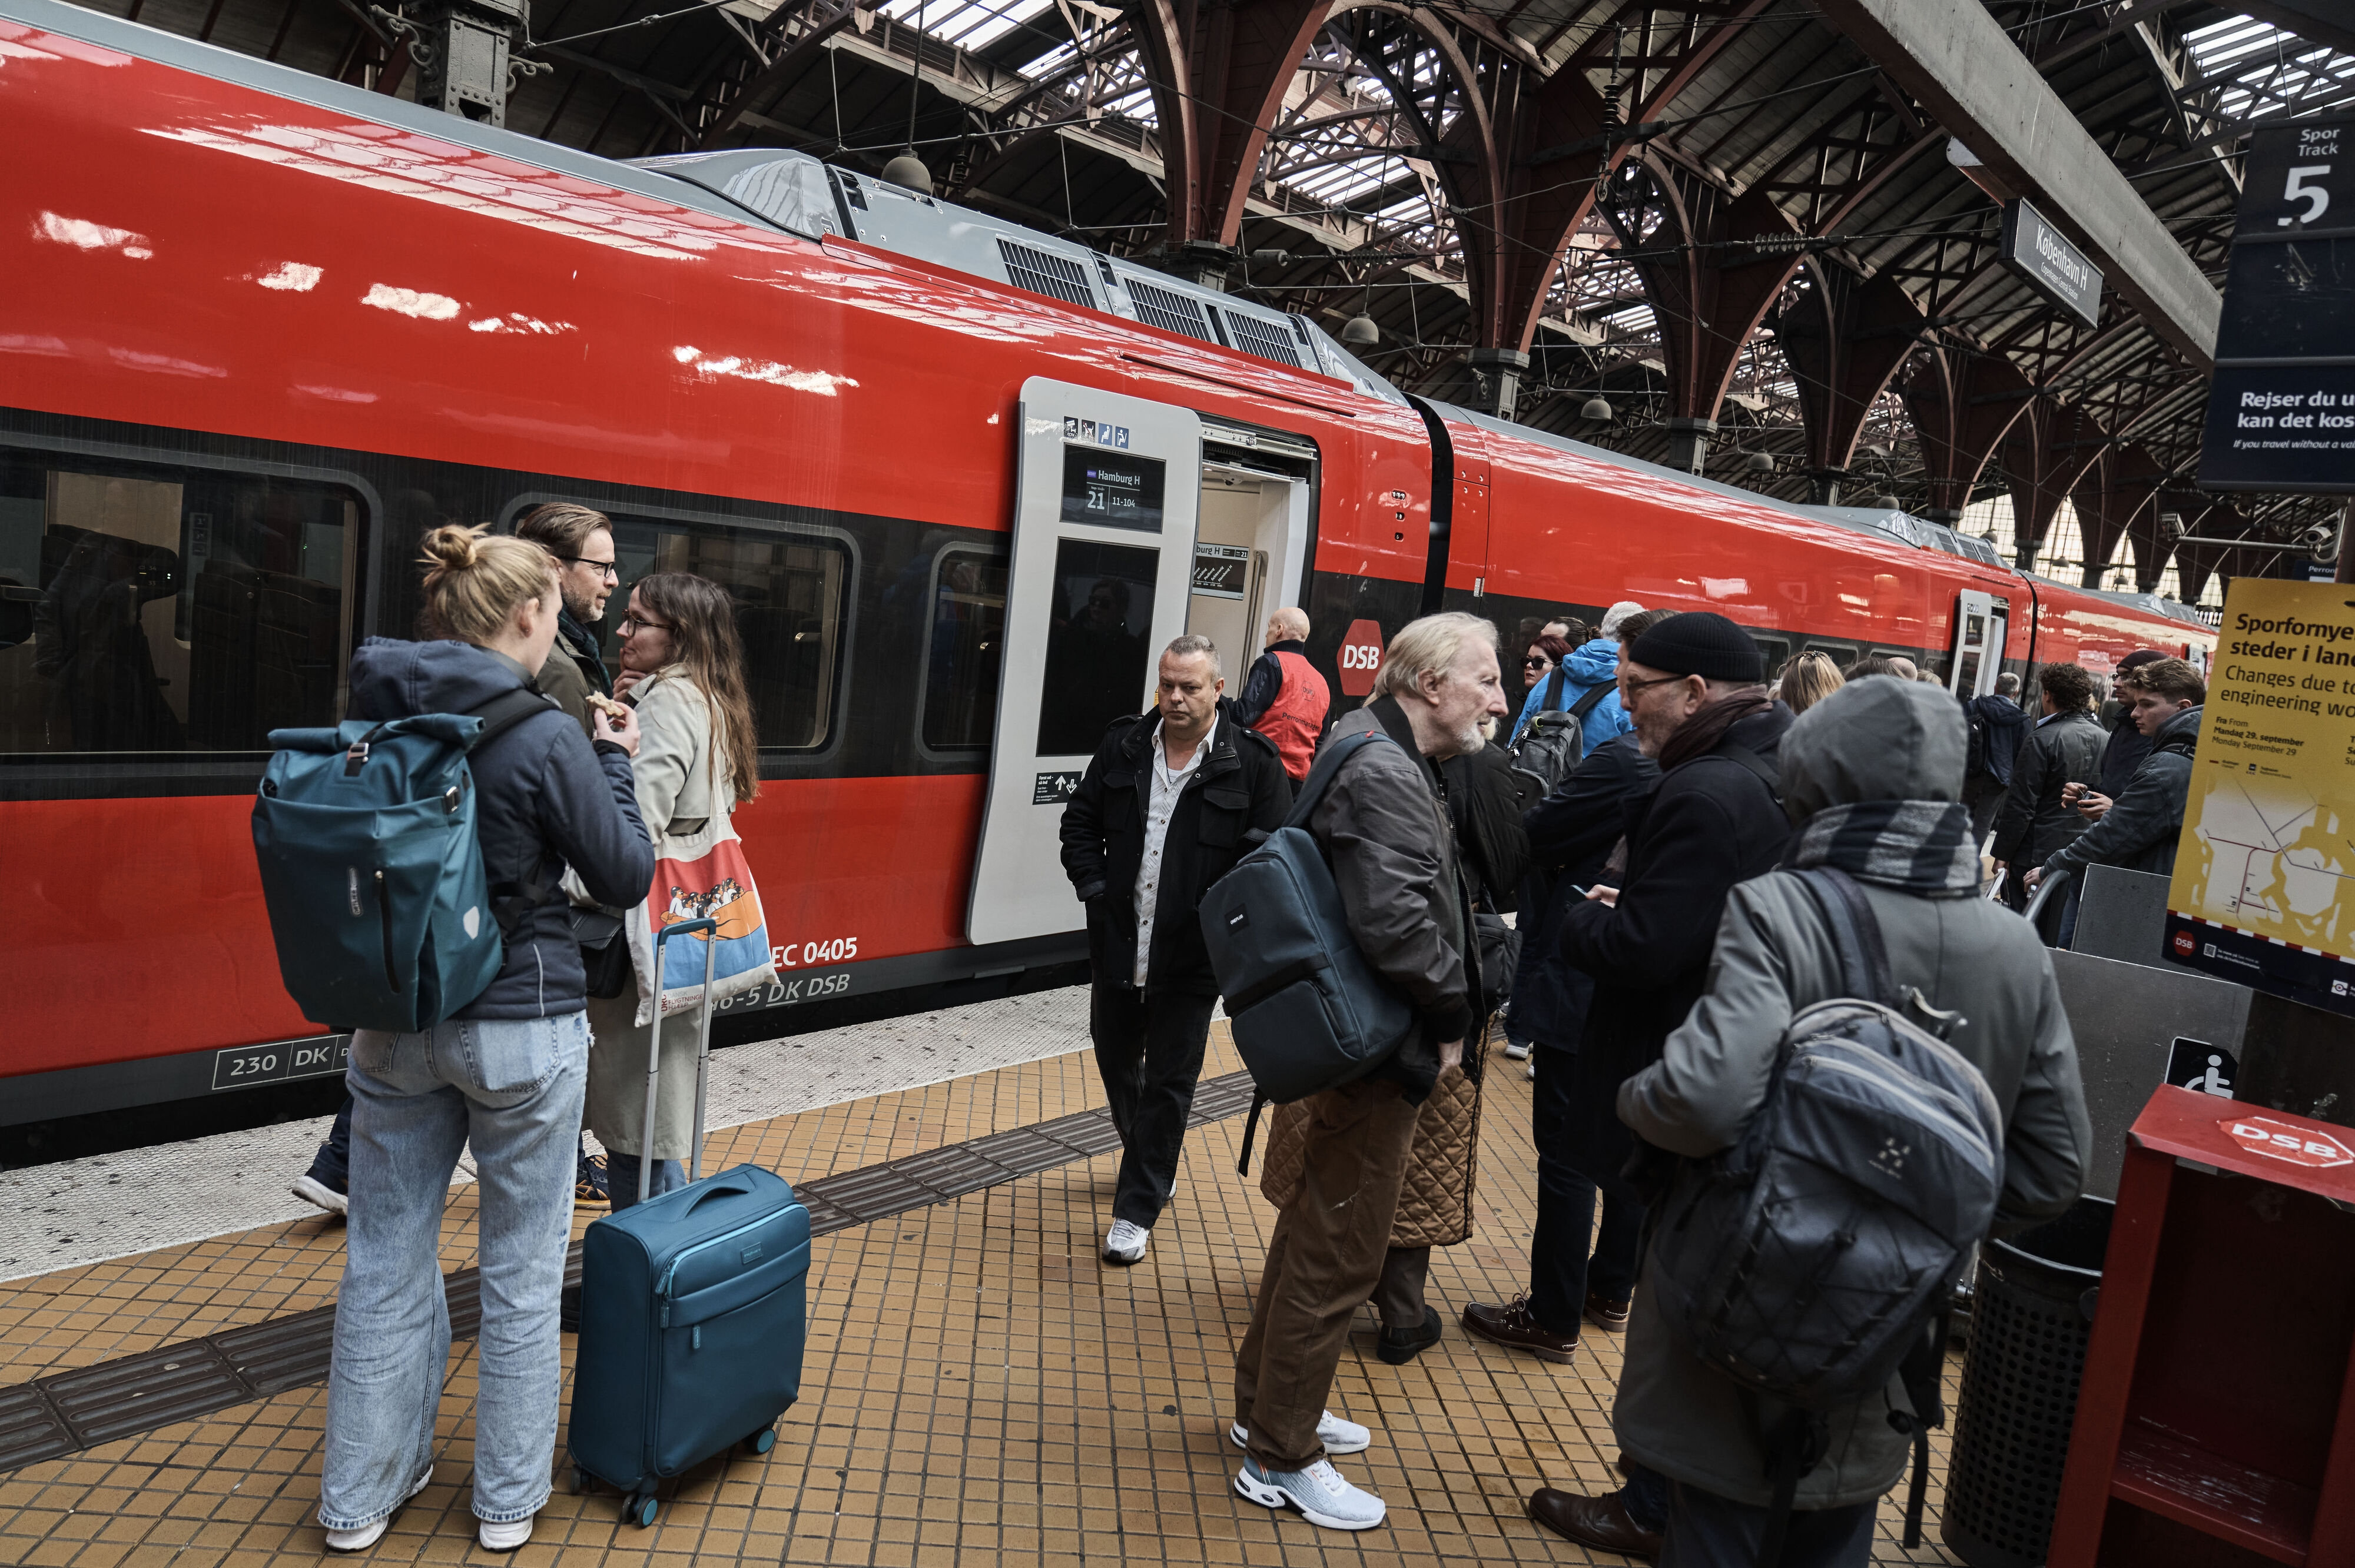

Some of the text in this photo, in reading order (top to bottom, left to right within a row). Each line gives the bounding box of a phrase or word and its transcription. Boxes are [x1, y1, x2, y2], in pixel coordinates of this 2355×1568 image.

[2301, 128, 2340, 142] Spor
[2298, 142, 2339, 157] Track
[2277, 165, 2331, 226] 5
[2036, 224, 2088, 291] København H
[2041, 262, 2078, 301] Copenhagen Central Station
[2241, 392, 2304, 410] Rejser
[2308, 390, 2336, 406] du
[2237, 412, 2274, 428] kan
[2279, 412, 2314, 428] det
[2233, 439, 2242, 448] If
[2241, 441, 2260, 450] you
[2261, 440, 2290, 449] travel
[2291, 440, 2330, 449] without
[1098, 470, 1133, 486] Hamburg
[1134, 476, 1140, 486] H
[1087, 491, 1135, 510] 21 11-104
[2235, 613, 2355, 643] Sporfornye
[1343, 645, 1379, 669] DSB
[2230, 640, 2297, 660] steder
[2302, 645, 2310, 662] i
[2225, 665, 2296, 688] Changes
[2301, 674, 2336, 692] due
[2221, 689, 2321, 716] engineering
[1282, 712, 1320, 731] Perronmanager
[2215, 716, 2248, 727] Fra From
[2211, 736, 2241, 748] Monday
[2243, 742, 2284, 755] September
[2214, 726, 2304, 747] Mandag 29. september
[772, 937, 857, 968] EC 0405
[2175, 938, 2193, 949] DSB
[767, 980, 803, 1002] DK
[807, 974, 850, 996] DSB
[668, 994, 704, 1005] FLYGTNINGE
[230, 1055, 277, 1076] 230
[295, 1047, 330, 1066] DK
[2231, 1123, 2337, 1158] DSB
